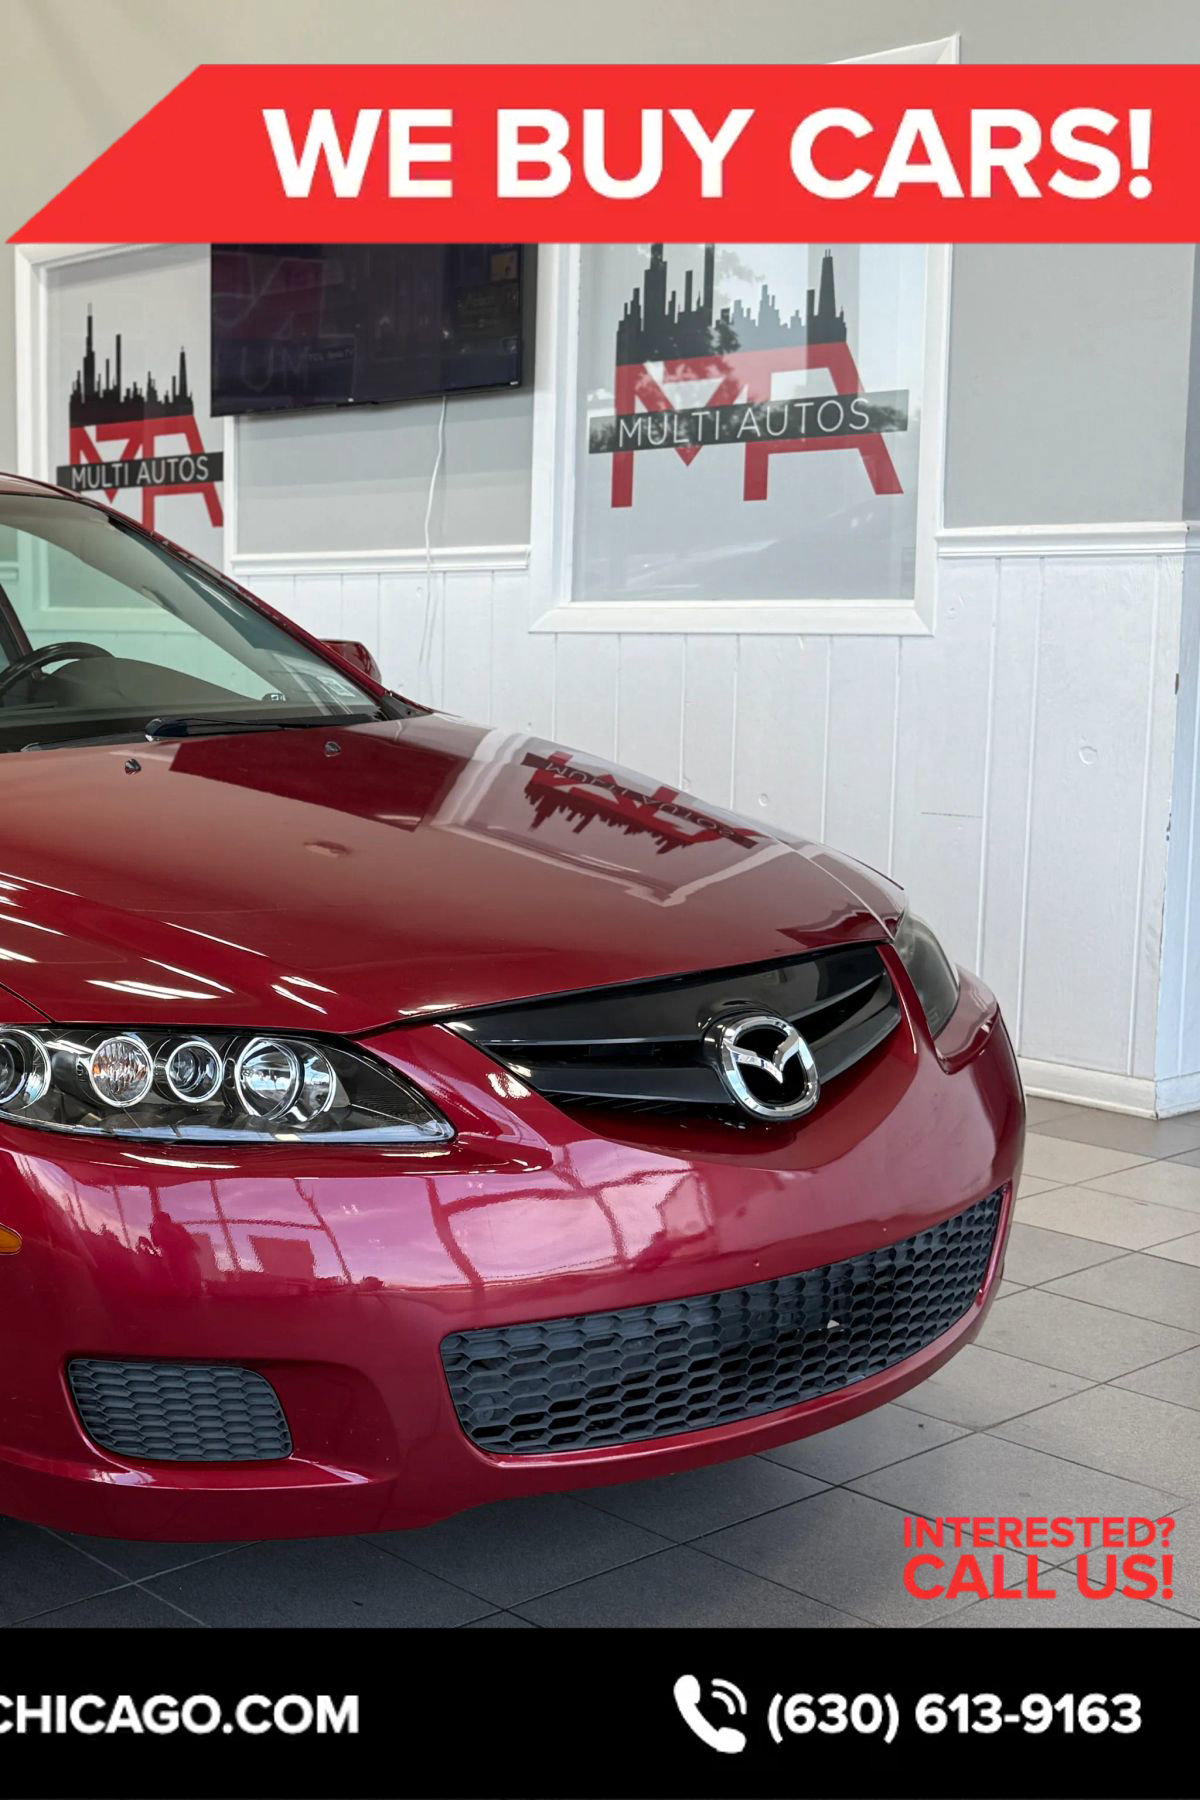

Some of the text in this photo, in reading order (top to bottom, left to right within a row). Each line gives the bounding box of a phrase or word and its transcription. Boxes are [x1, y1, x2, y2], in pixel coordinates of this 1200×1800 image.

[618, 397, 870, 449] MULTI AUTOS
[71, 455, 209, 489] MULTI AUTOS
